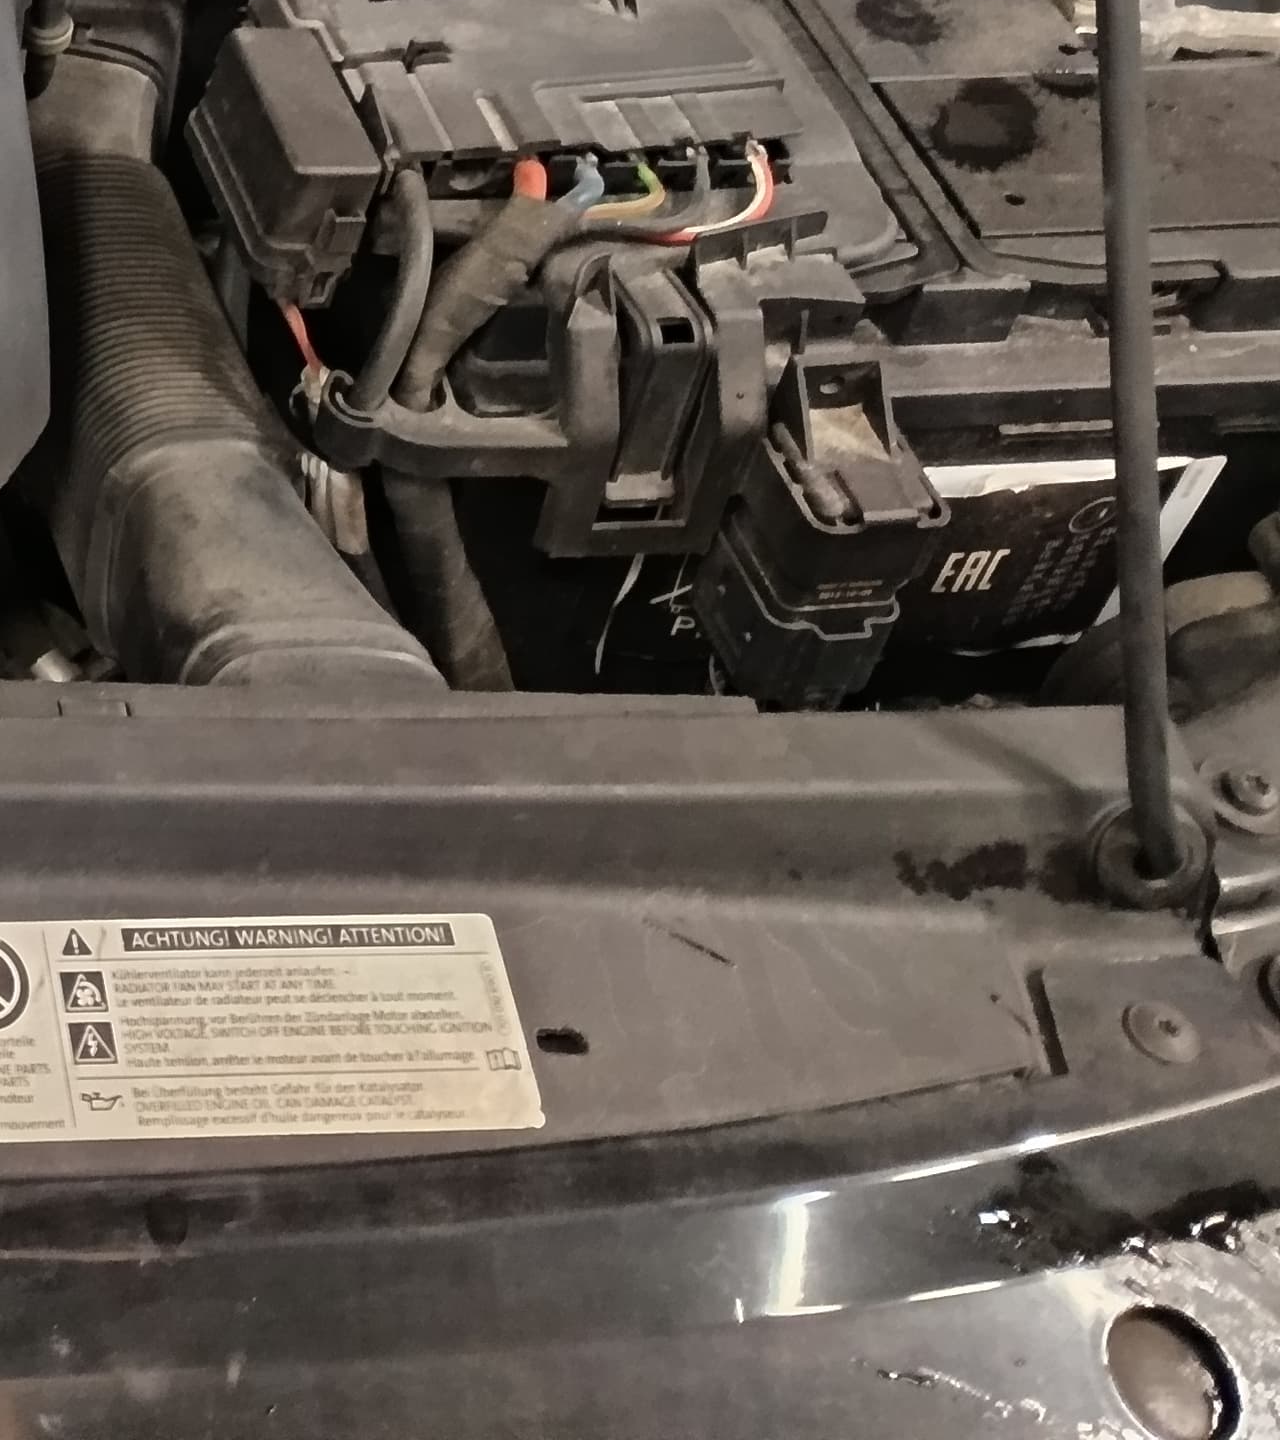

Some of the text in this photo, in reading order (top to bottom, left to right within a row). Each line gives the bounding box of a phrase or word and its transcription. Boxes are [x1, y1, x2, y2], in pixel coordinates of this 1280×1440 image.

[930, 548, 1011, 593] EAC
[132, 925, 445, 949] ACHTUNG! WARNING! ATTENTION!
